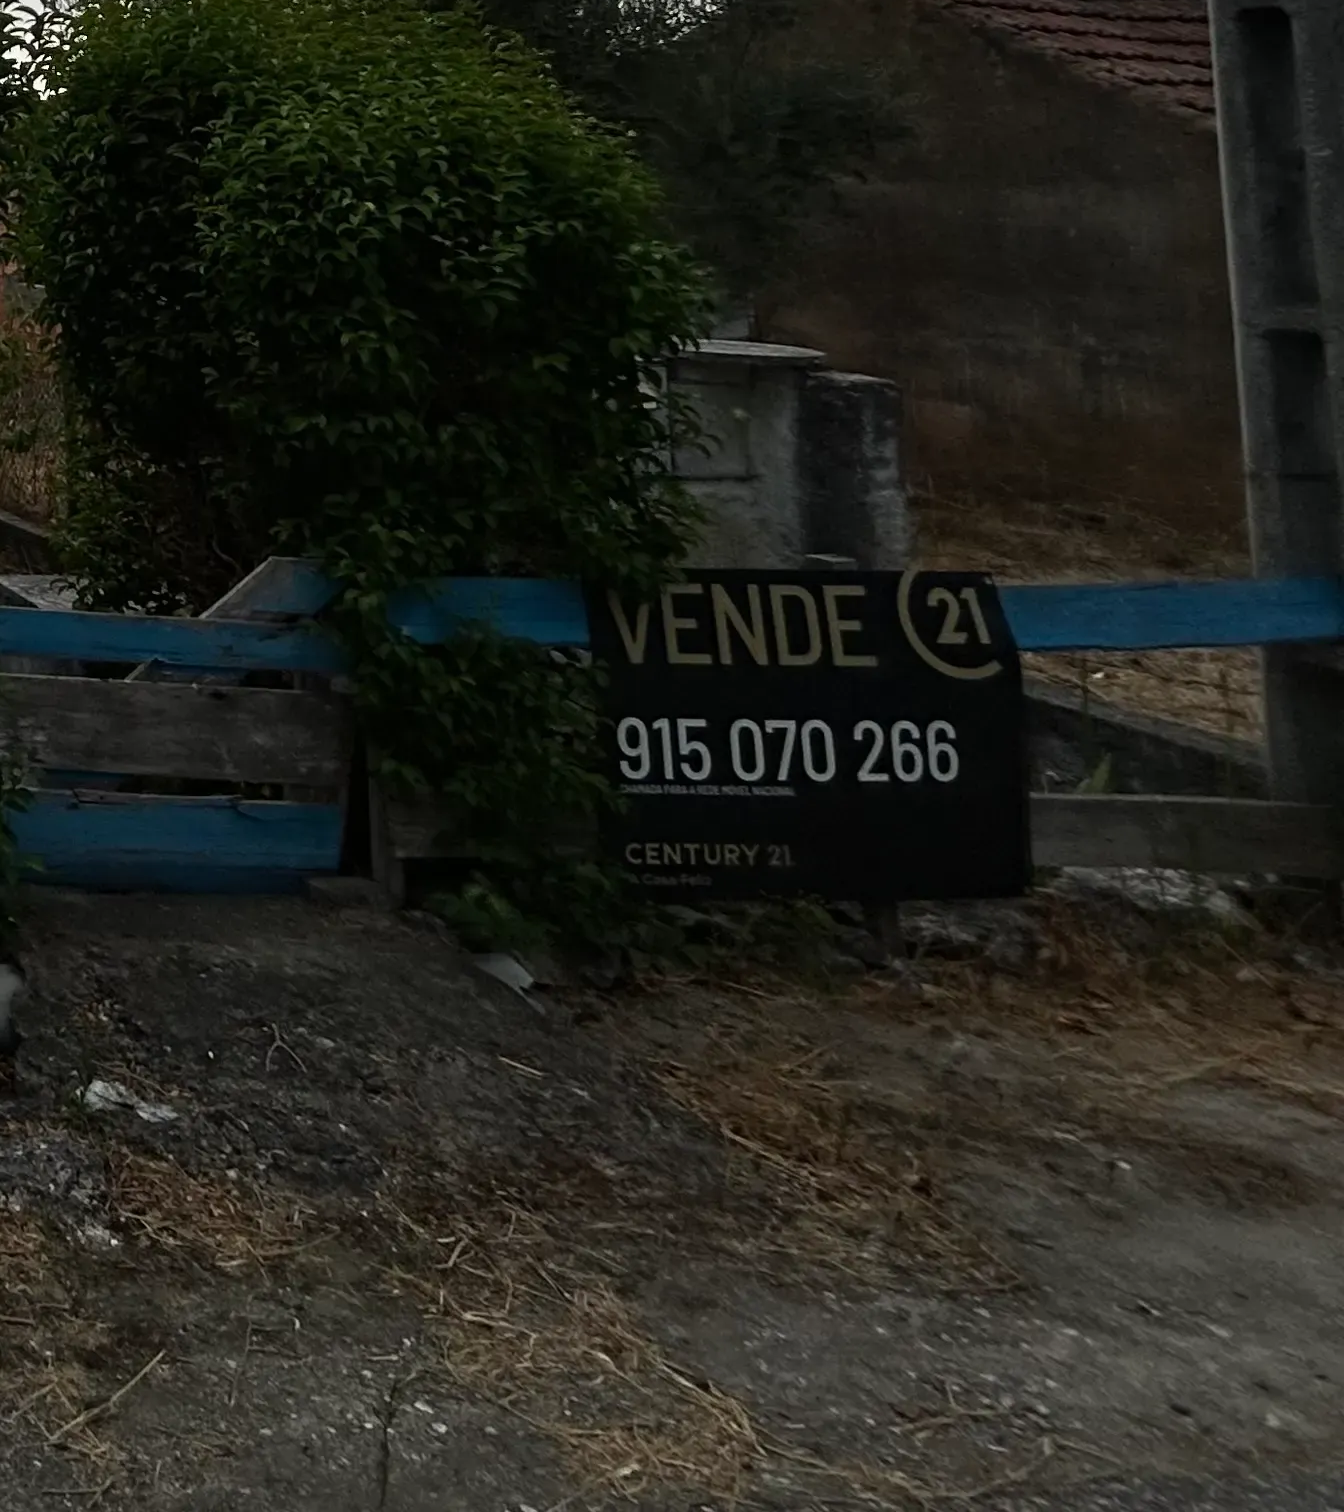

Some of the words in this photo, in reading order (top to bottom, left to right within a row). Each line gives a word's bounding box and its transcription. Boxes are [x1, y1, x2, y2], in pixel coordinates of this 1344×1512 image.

[607, 584, 879, 667] VENDE
[617, 717, 712, 781] 915
[729, 718, 837, 782] 070
[853, 719, 960, 783] 266
[625, 843, 760, 867] CENTURY
